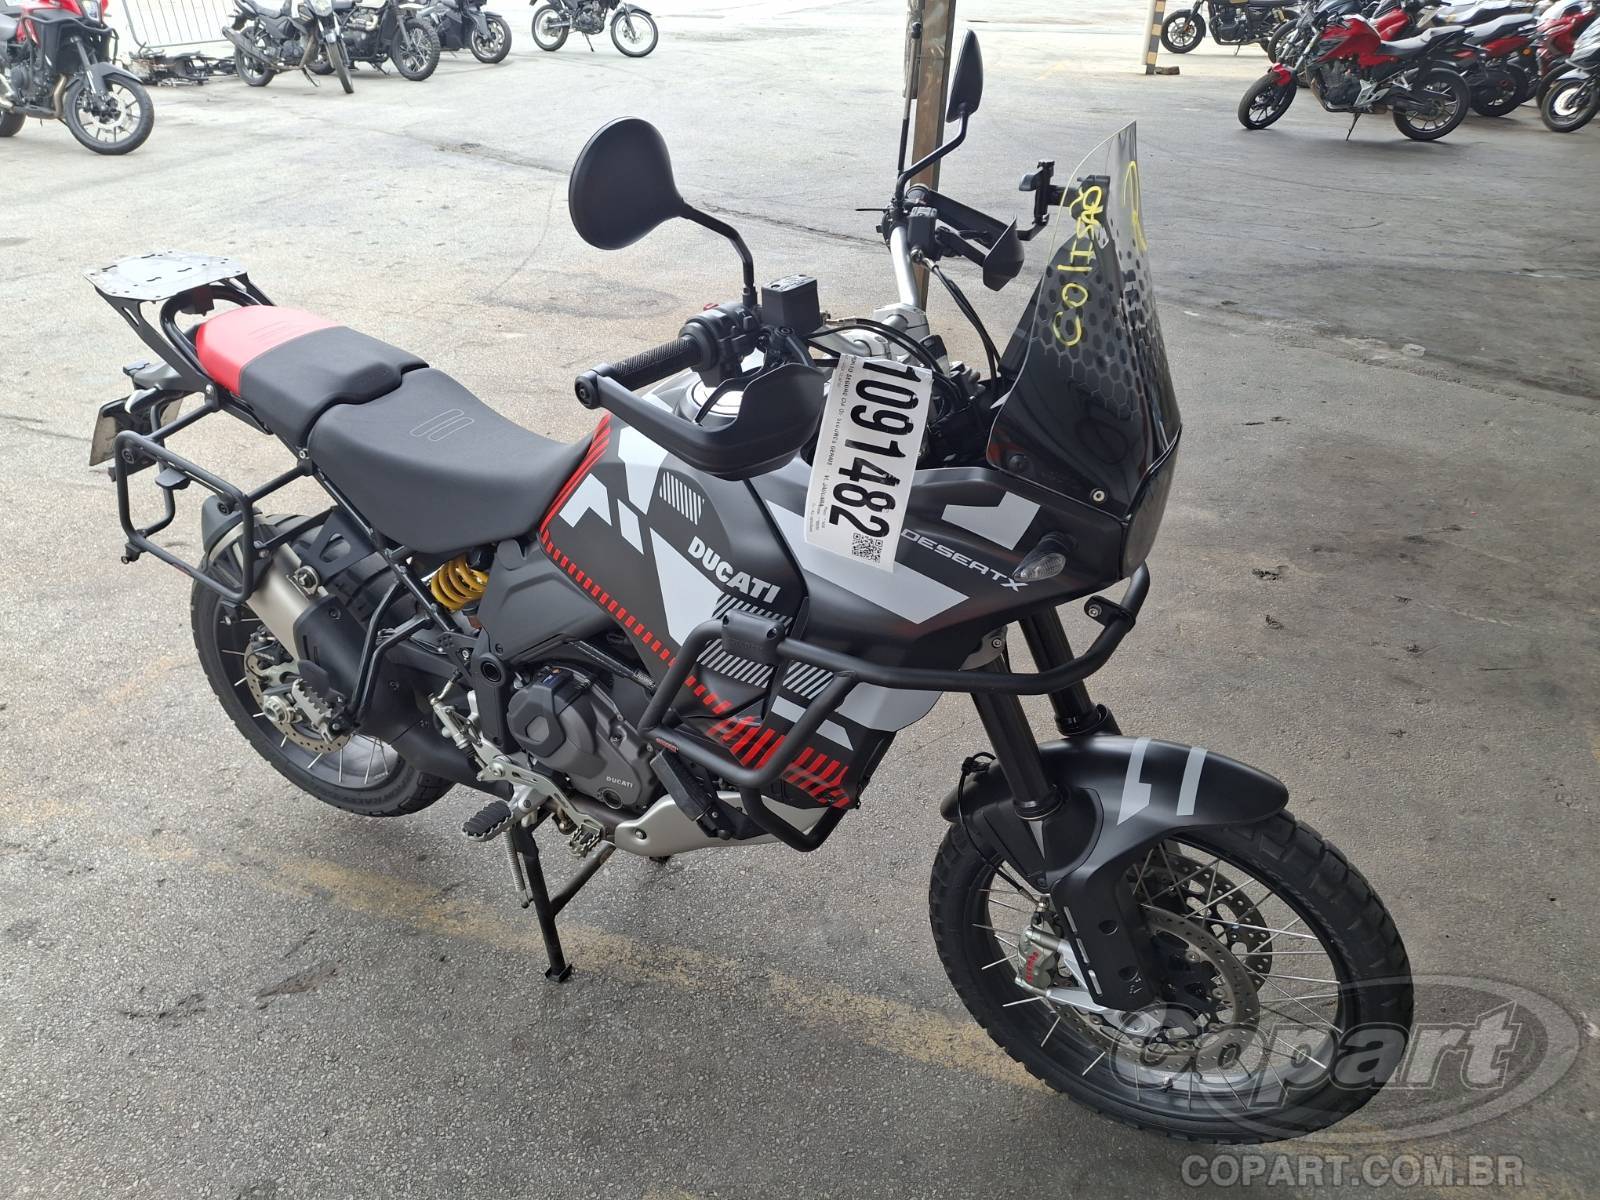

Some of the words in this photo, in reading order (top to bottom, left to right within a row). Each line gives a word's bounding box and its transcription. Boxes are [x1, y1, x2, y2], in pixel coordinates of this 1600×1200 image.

[828, 361, 922, 538] 1091482
[687, 535, 781, 604] DUCATI
[606, 775, 634, 788] DUCATI
